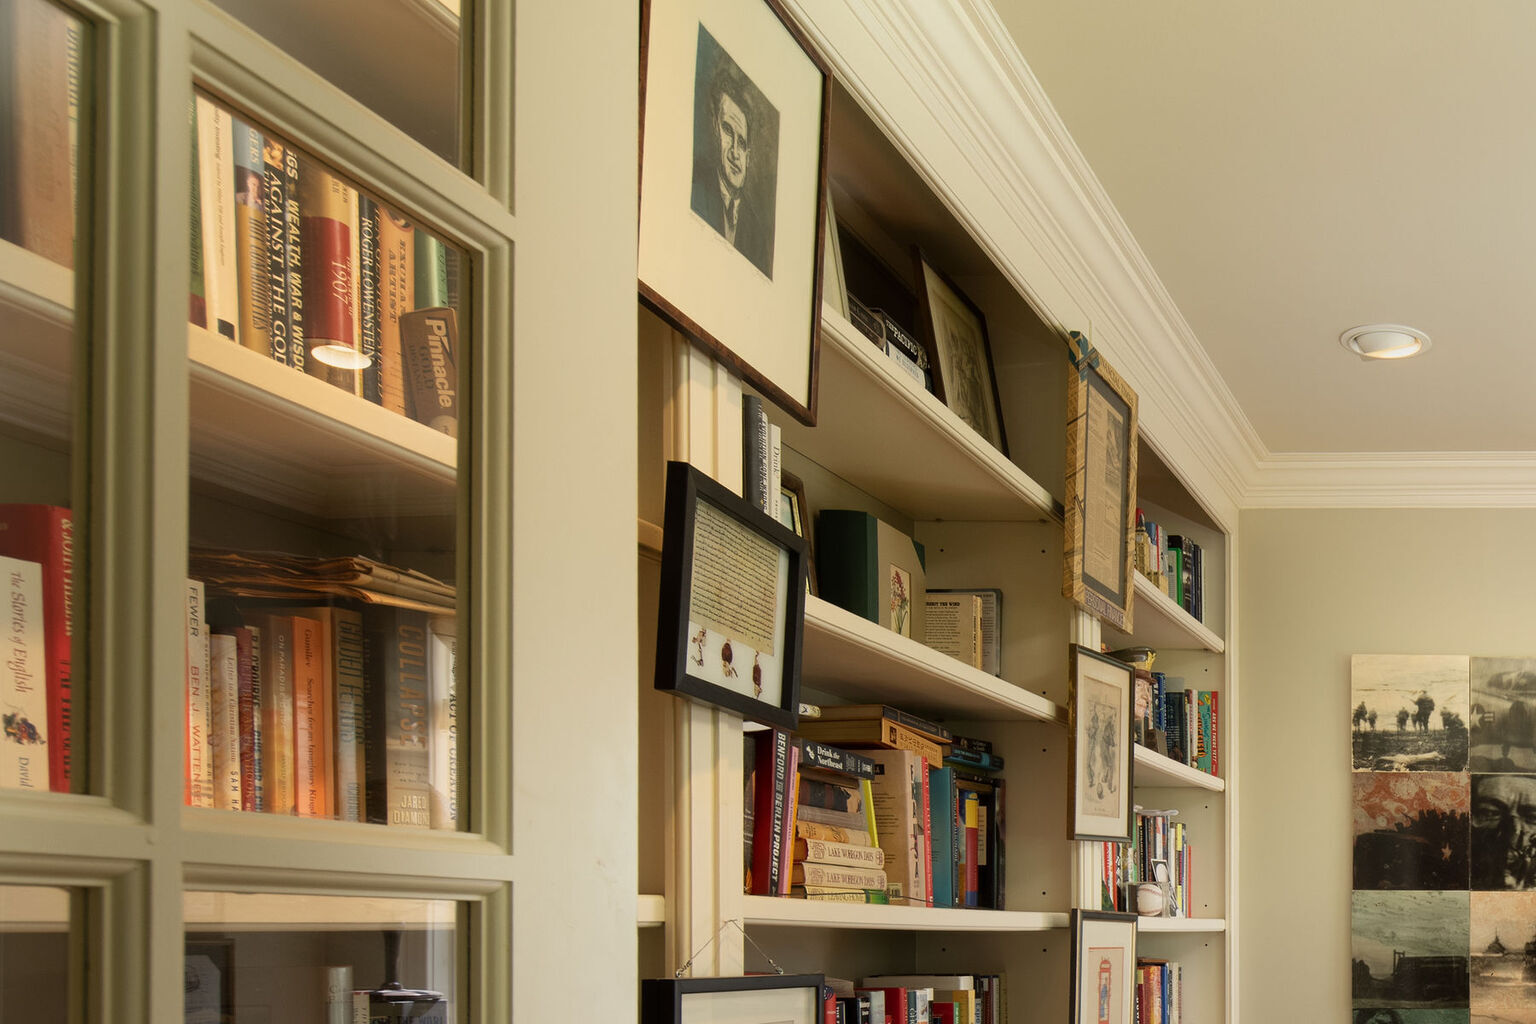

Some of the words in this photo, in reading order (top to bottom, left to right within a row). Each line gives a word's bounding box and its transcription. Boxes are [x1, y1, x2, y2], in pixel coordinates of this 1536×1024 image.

[268, 170, 285, 268] AGAINST
[288, 199, 302, 267] WEALTH,
[360, 217, 375, 268] ROGER
[271, 272, 286, 317] THE
[290, 271, 303, 310] WAR
[331, 260, 349, 305] 1907
[292, 311, 303, 321] &
[361, 269, 376, 361] LOWENSTEIN
[424, 317, 456, 409] Pinnacle
[10, 592, 28, 638] Stories
[188, 586, 200, 638] FEWER
[15, 637, 23, 646] of
[304, 630, 313, 667] Gumilev
[338, 620, 363, 679] GOLDEN
[6, 650, 34, 693] English
[190, 665, 201, 697] BEN
[399, 624, 425, 749] COLLAPSE
[306, 678, 315, 714] Searches
[339, 682, 364, 745] FETTERS
[17, 756, 34, 788] David
[307, 744, 316, 785] Imaginary
[775, 733, 786, 780] BENFORD
[816, 744, 832, 759] Drink
[231, 770, 239, 793] SAM
[401, 794, 428, 810] JARED
[771, 835, 781, 882] PROJECT
[827, 846, 841, 858] LAKE
[840, 847, 864, 861] WOBEGON
[826, 872, 841, 884] LAKE
